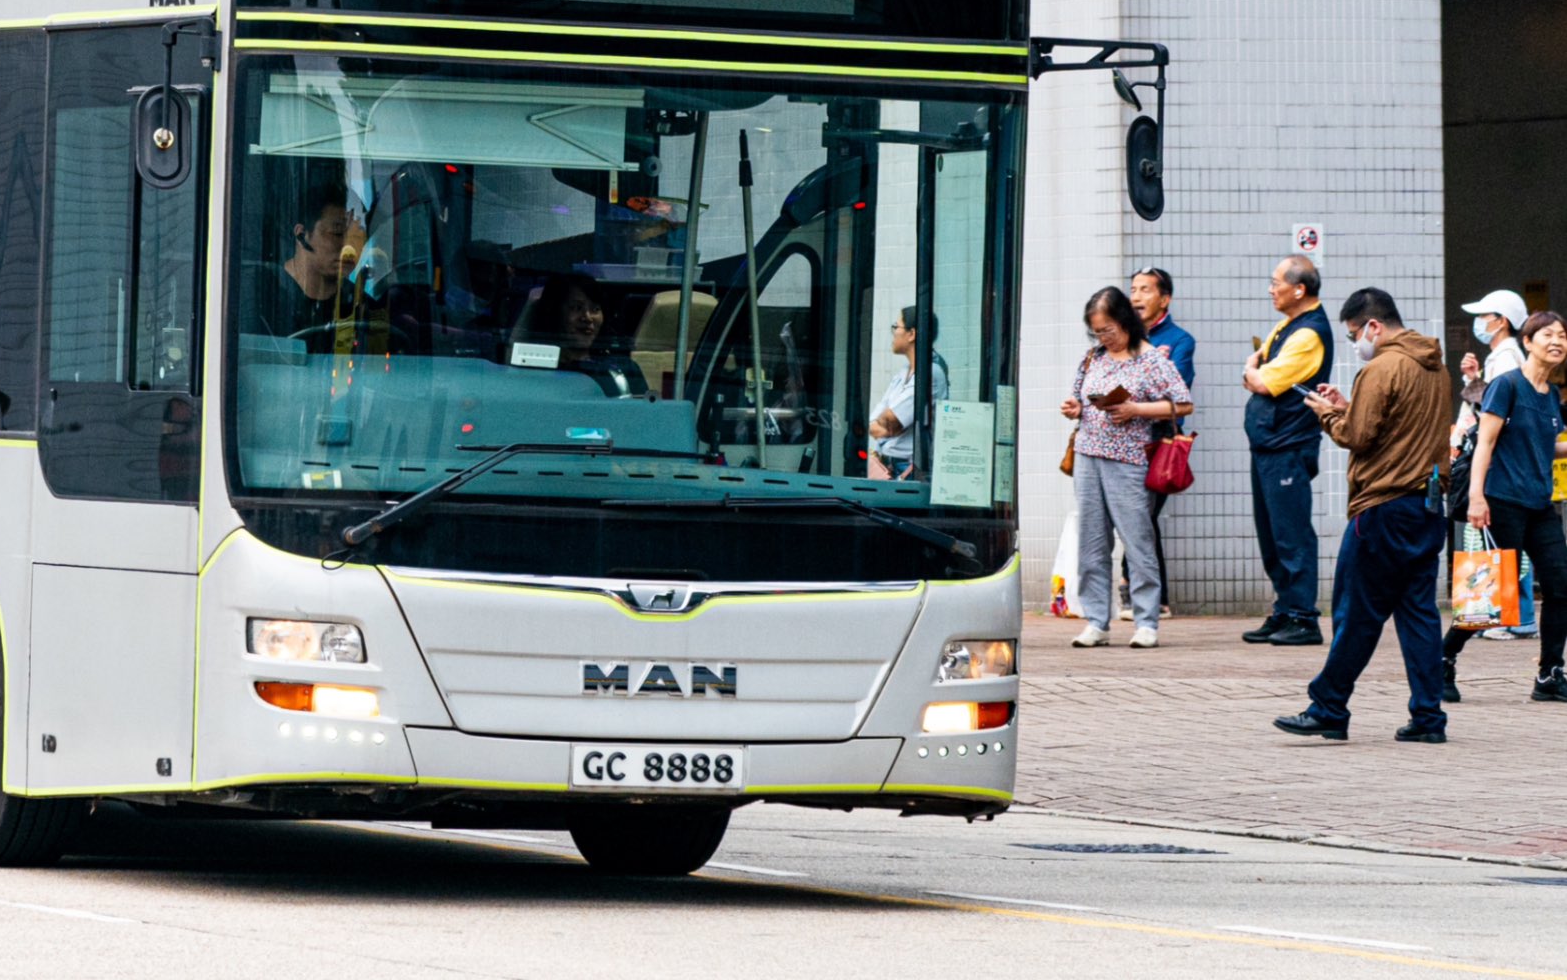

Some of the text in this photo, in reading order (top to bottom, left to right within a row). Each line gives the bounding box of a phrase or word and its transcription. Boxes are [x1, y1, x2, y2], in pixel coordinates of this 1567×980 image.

[580, 660, 737, 697] MAN
[583, 750, 734, 783] GC 8888
